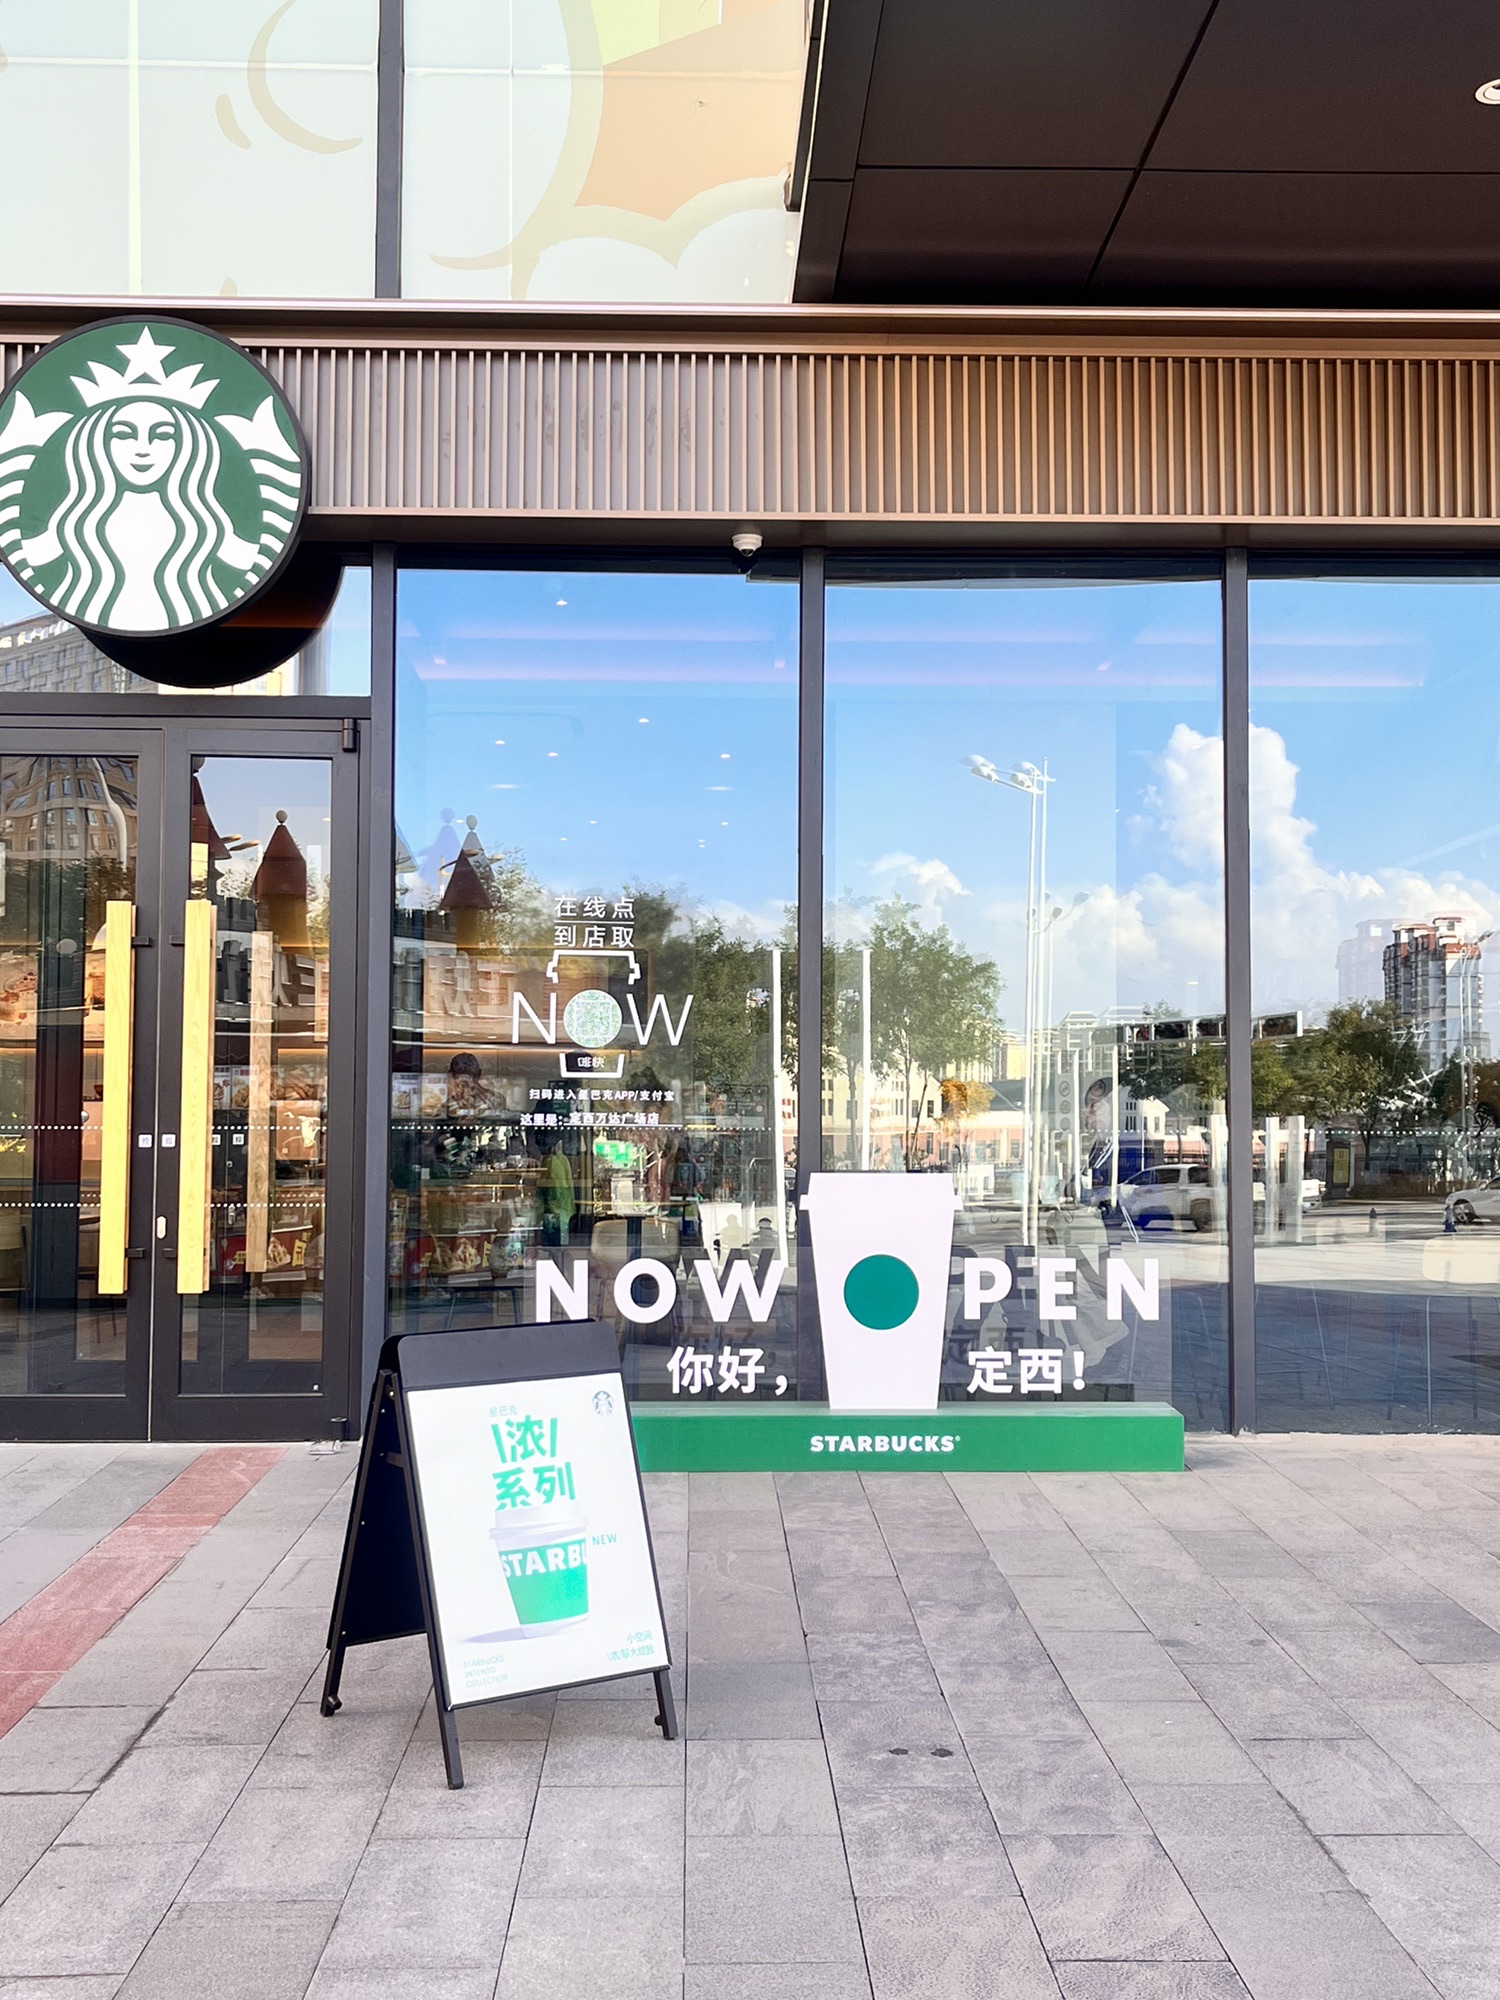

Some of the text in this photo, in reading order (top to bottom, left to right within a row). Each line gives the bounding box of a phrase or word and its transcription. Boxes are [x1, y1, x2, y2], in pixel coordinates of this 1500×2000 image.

[553, 895, 635, 919] 在线点
[553, 925, 635, 948] 到店取
[577, 1056, 605, 1069] 啡快
[535, 1258, 786, 1324] NOW
[489, 1404, 519, 1418] 星巴克
[492, 1461, 576, 1511] 系列
[592, 1533, 617, 1546] NEW
